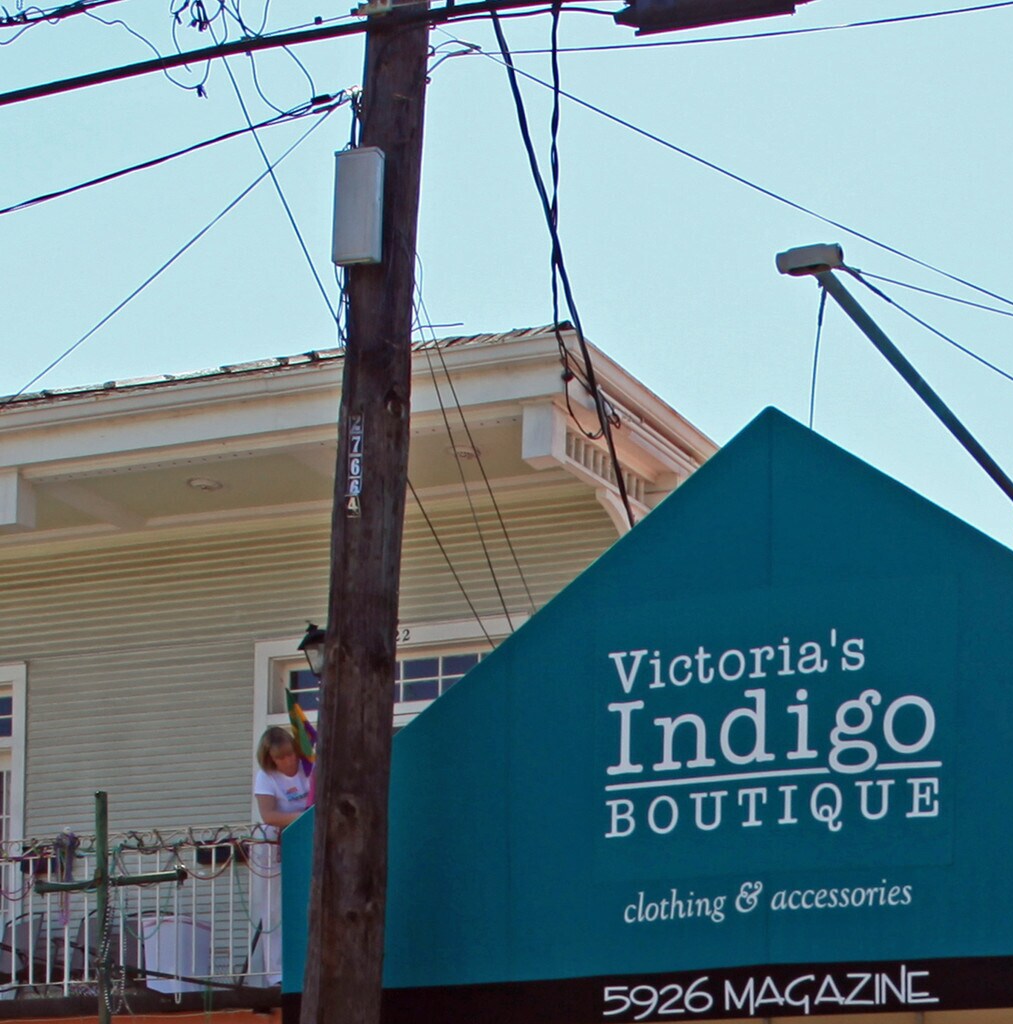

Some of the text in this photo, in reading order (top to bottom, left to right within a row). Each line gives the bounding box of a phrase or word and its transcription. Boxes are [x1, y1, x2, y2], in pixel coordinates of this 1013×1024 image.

[608, 628, 865, 693] Victoria's
[606, 688, 936, 775] Indigo
[605, 777, 939, 838] BOUTIQUE
[623, 879, 912, 923] clothing & accessories
[603, 964, 939, 1020] 5926 MAGAZINE
